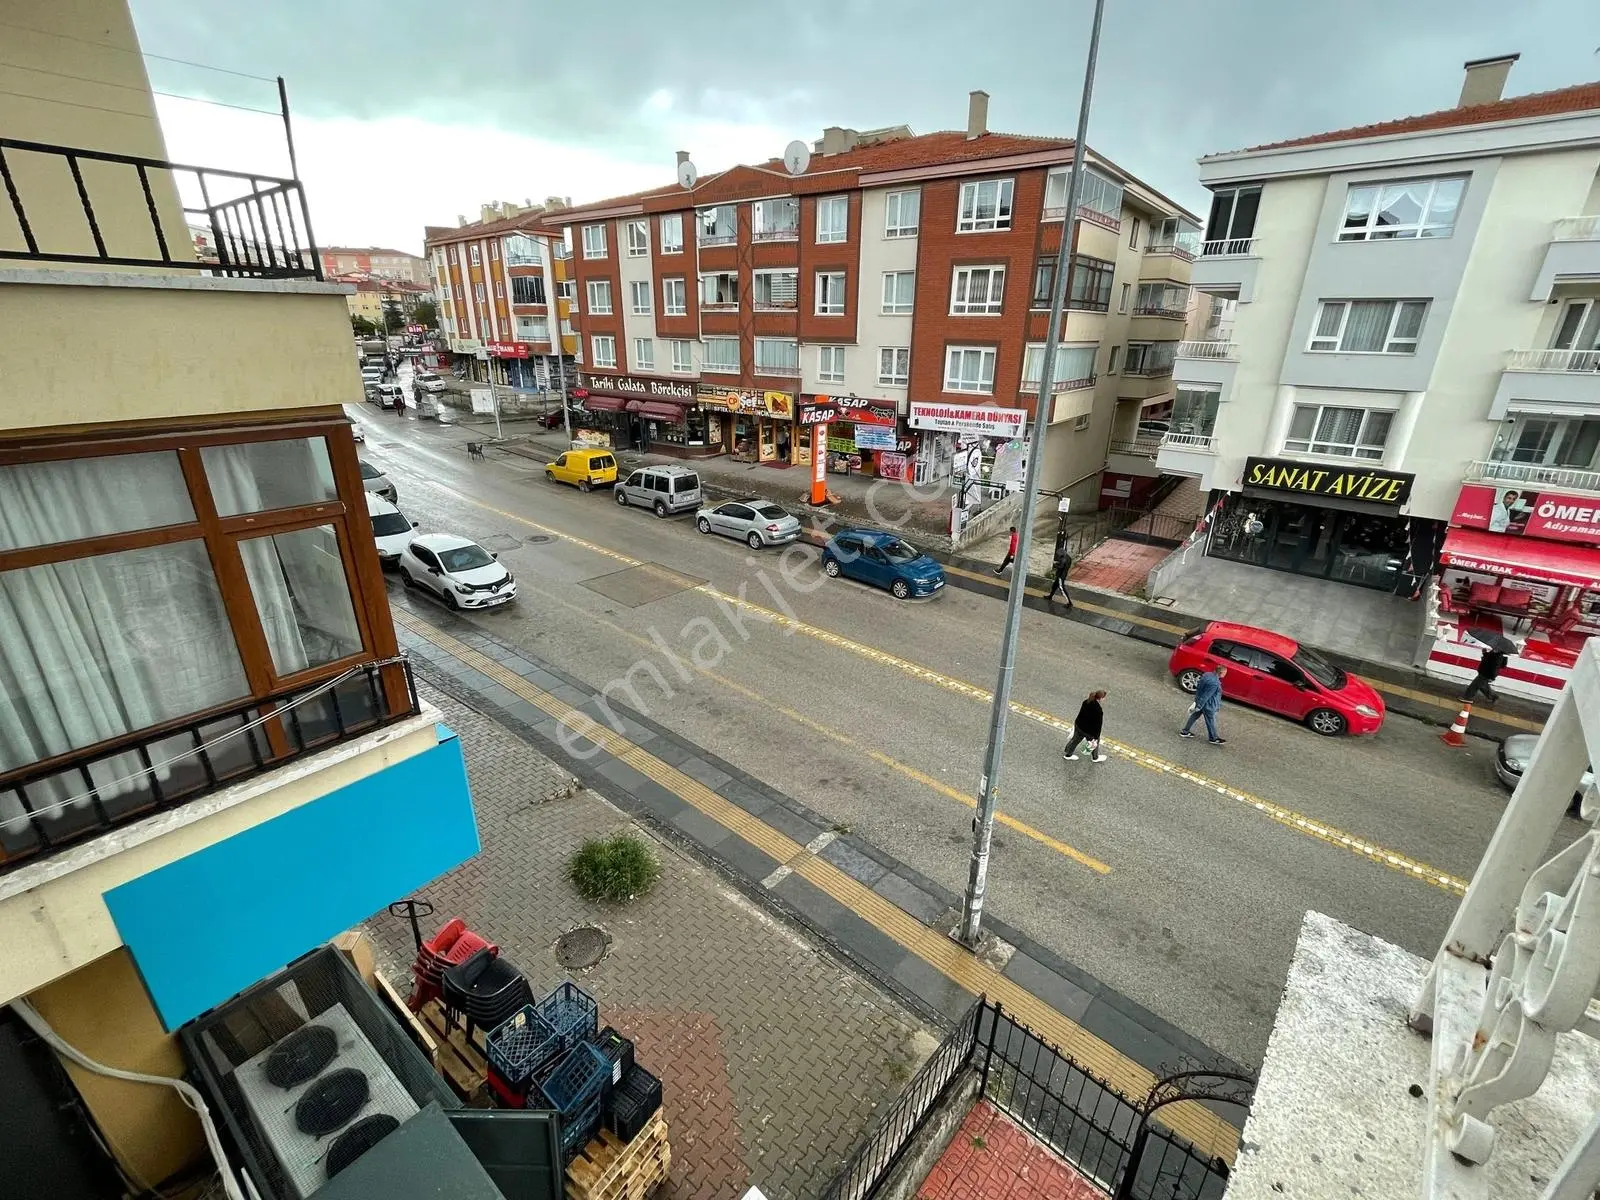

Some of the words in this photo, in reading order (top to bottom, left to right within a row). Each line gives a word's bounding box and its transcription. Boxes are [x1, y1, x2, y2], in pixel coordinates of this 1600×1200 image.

[590, 377, 614, 390] Tarihi
[618, 378, 646, 392] Galata
[651, 381, 692, 398] Börekçisi
[802, 409, 834, 424] KASAP
[1249, 464, 1329, 492] SANAT
[1325, 472, 1405, 501] AVİZE
[1450, 557, 1478, 569] ÖMER
[1479, 563, 1513, 575] AYBAK
